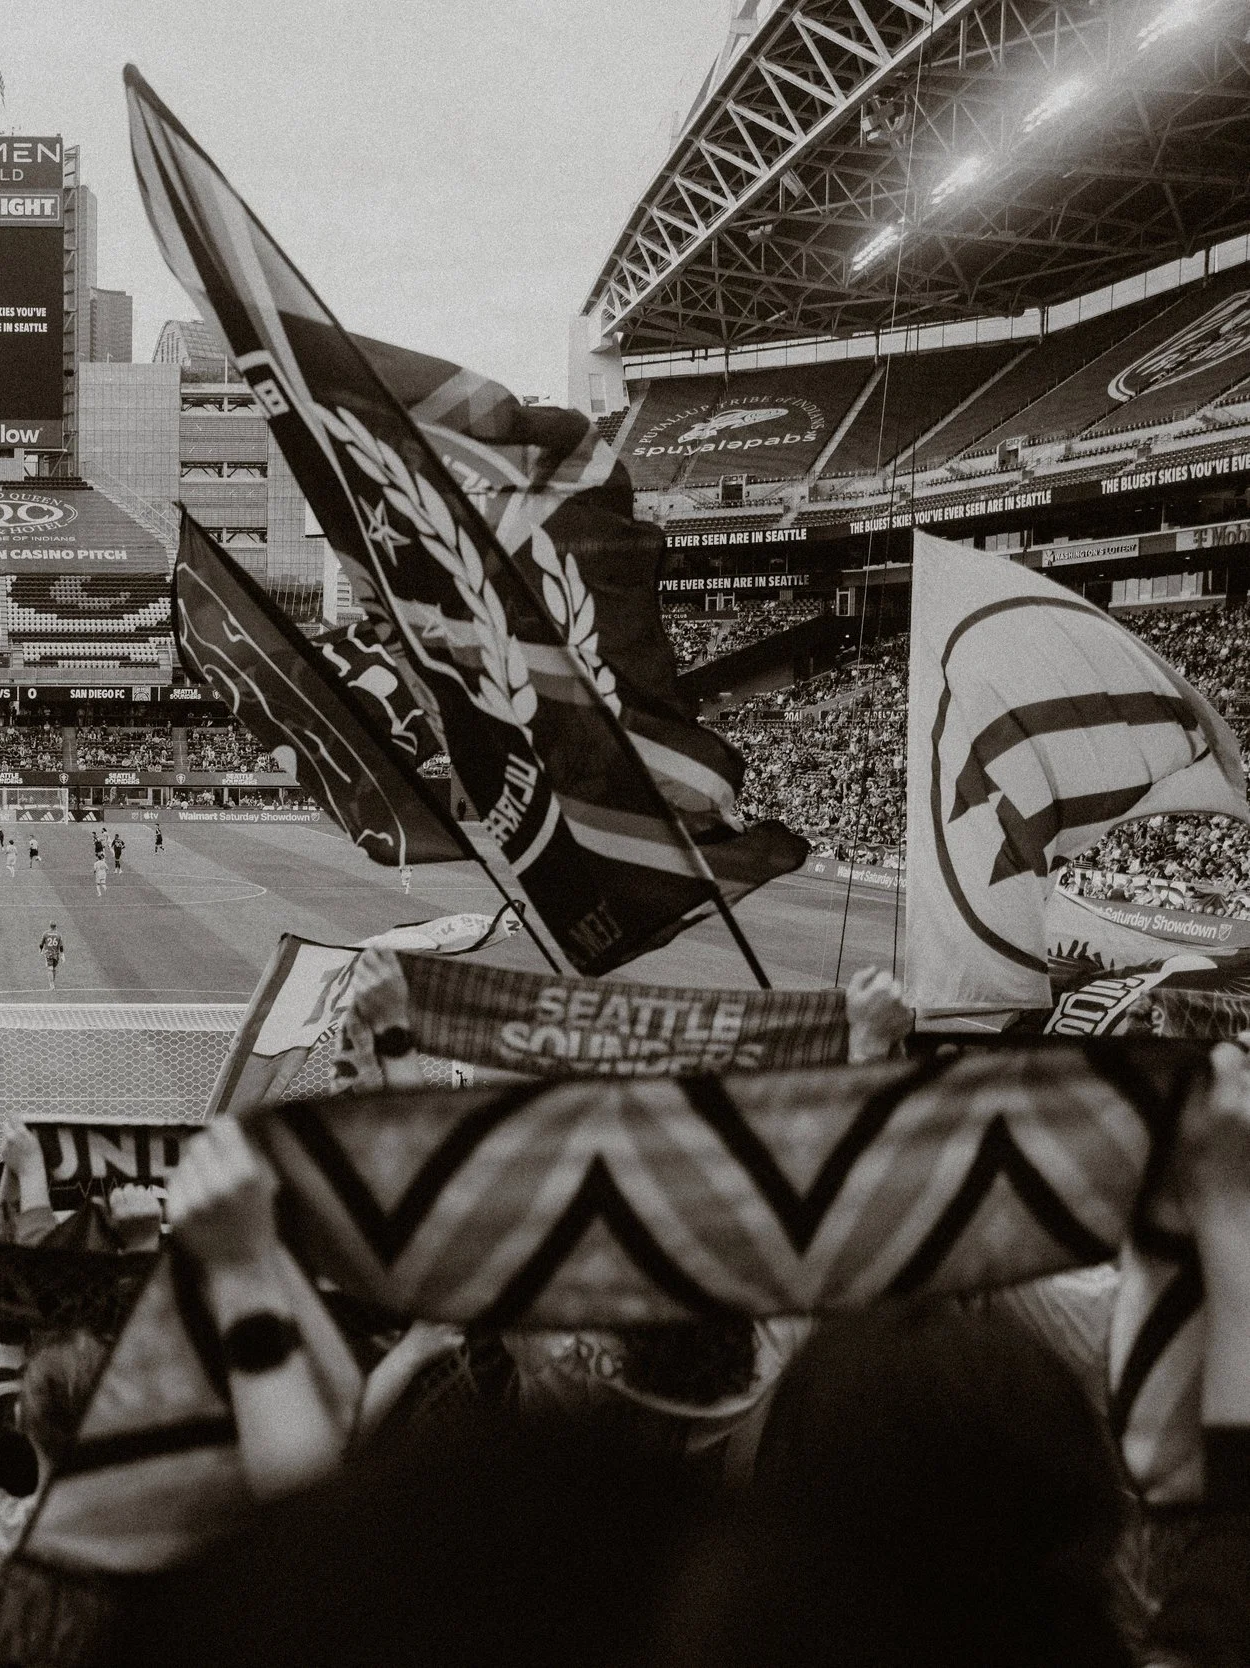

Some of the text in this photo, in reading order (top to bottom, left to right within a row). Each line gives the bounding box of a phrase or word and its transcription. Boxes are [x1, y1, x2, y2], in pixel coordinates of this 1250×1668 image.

[16, 306, 47, 317] YOU'VE
[3, 322, 13, 332] IN
[14, 322, 48, 333] SEATTLE
[718, 396, 772, 410] TRIBE
[793, 398, 825, 430] INDIANS
[1101, 454, 1250, 494] THE BLUEST SKIES YOU'VE EVE
[9, 491, 63, 507] QUEEN
[850, 521, 864, 534] THE
[865, 517, 890, 532] BLUEST
[914, 508, 943, 525] YOU'VE
[944, 505, 964, 520] EVER
[965, 502, 986, 517] SEEN
[987, 500, 1003, 514] ARE
[1005, 497, 1015, 510] IN
[1016, 489, 1052, 509] SEATTLE
[9, 519, 68, 534] HOTEL
[675, 535, 700, 547] EVER
[702, 534, 727, 546] SEEN
[729, 532, 750, 545] ARE
[751, 531, 763, 543] IN
[765, 528, 807, 543] SEATTLE
[10, 549, 74, 560] CASINO
[77, 549, 127, 560] PITCH
[680, 578, 704, 590] EVER
[707, 577, 731, 589] SEEN
[733, 576, 753, 588] ARE
[755, 576, 766, 587] IN
[768, 574, 810, 587] SEATTLE
[28, 688, 37, 699] 0
[70, 688, 125, 699] SAN DIEGO FC
[150, 812, 310, 823] tv Walmart Saturday Showdown
[1106, 908, 1217, 940] Saturday Showdown
[47, 937, 59, 946] 26
[536, 986, 748, 1043] SEATTLE
[497, 1020, 763, 1075] SOUNDERS
